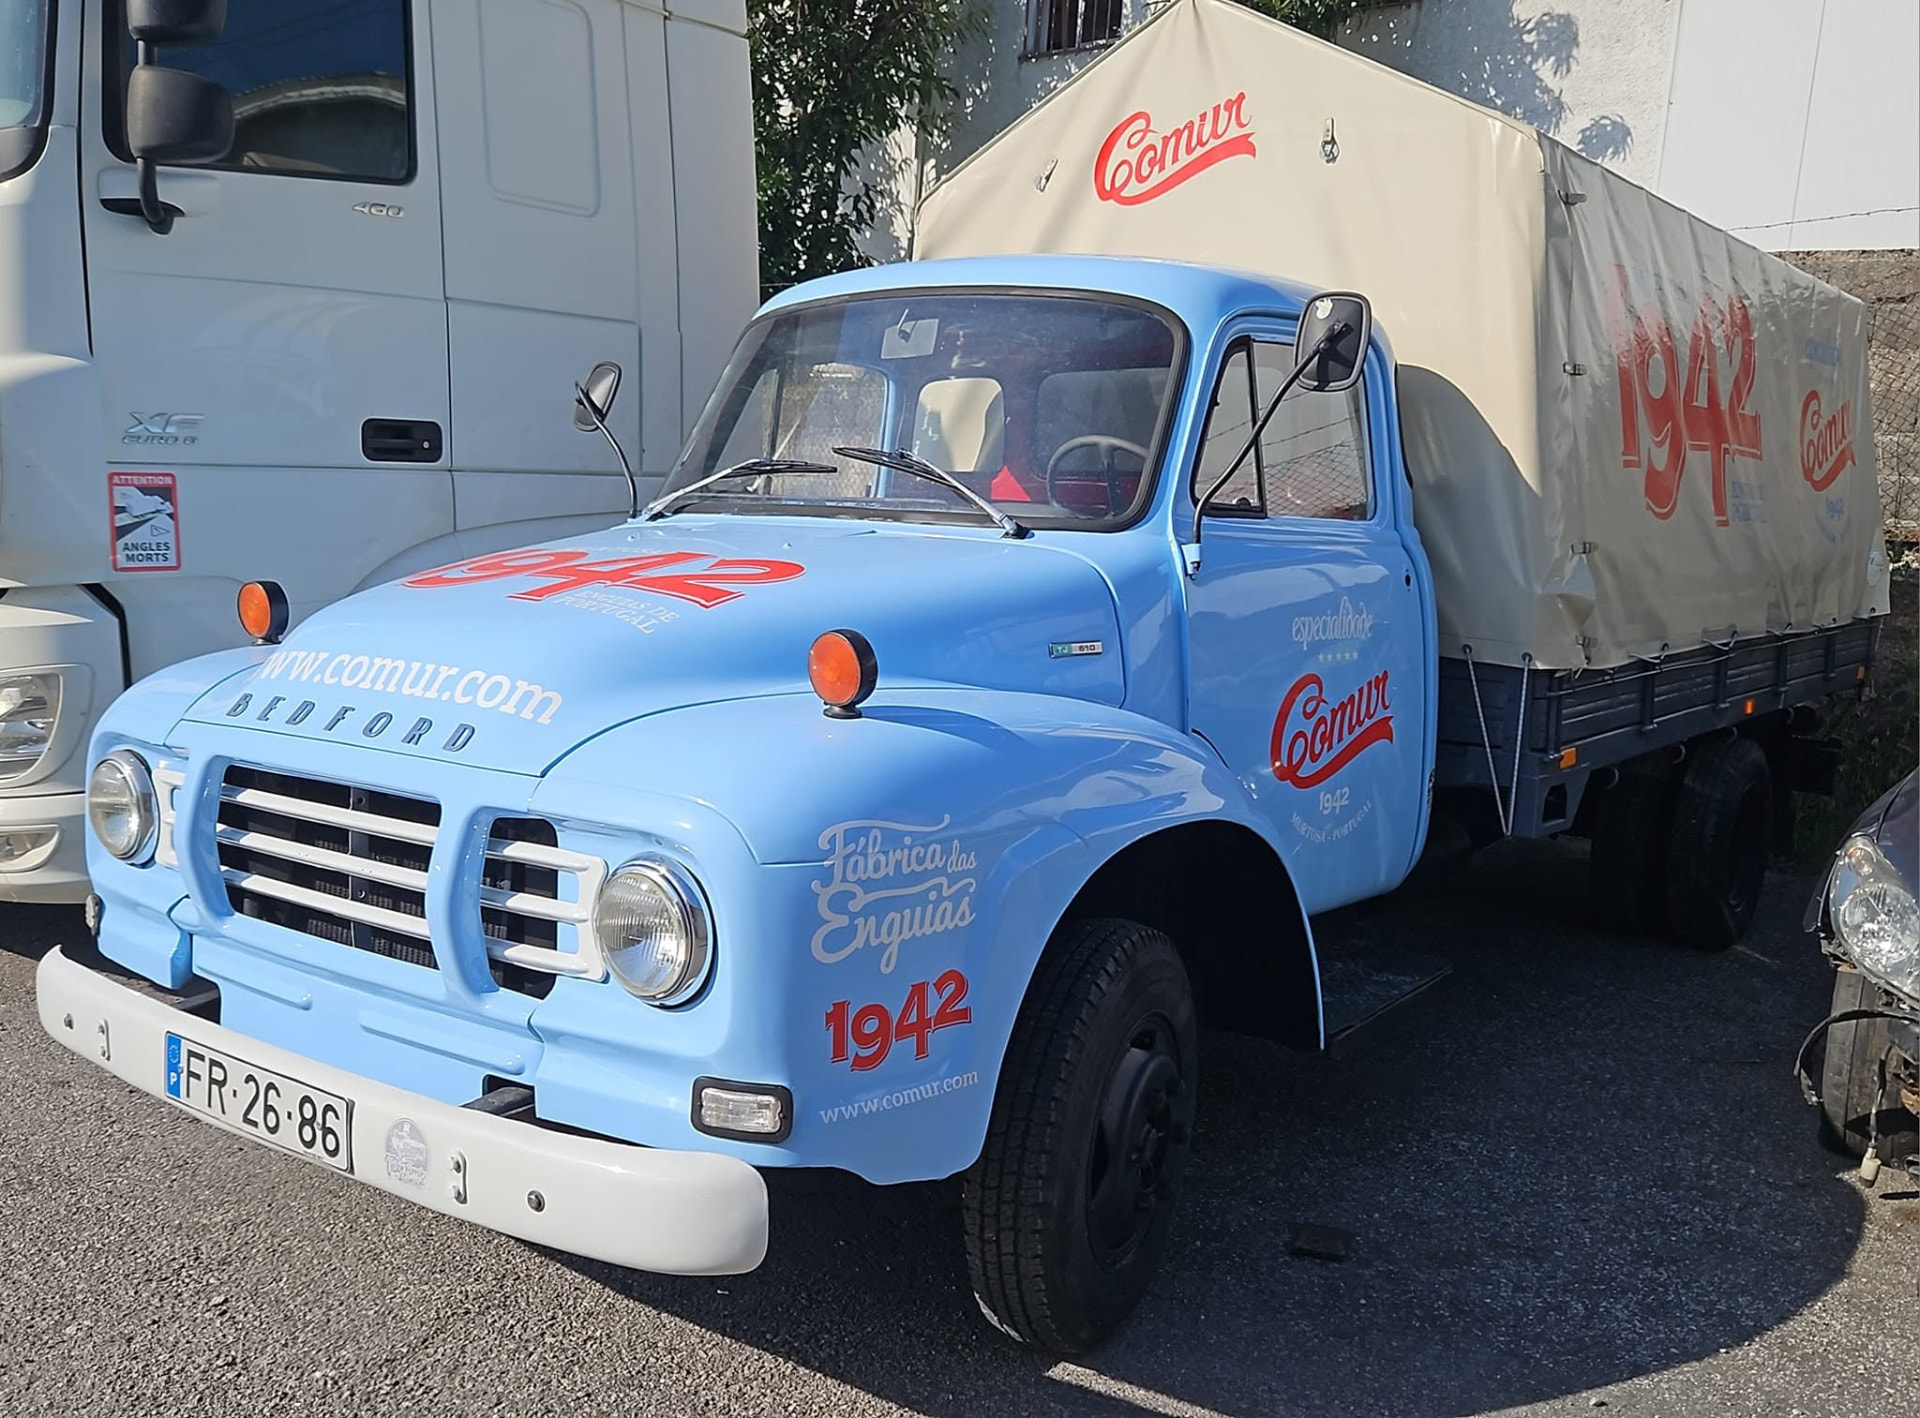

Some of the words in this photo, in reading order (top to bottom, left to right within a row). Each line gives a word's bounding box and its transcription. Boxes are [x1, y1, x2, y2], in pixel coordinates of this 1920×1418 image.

[1094, 91, 1256, 206] Comur
[351, 201, 405, 219] 460
[1604, 263, 1763, 527] 1942
[124, 411, 205, 434] XF
[112, 475, 173, 485] ATTENTION
[122, 541, 171, 552] ANGLES
[125, 552, 169, 563] MORTS
[647, 606, 680, 623] DE
[1292, 596, 1373, 651] especialidade
[254, 651, 564, 726] ww.comur.com
[226, 692, 476, 752] BEDFORD
[1271, 670, 1394, 790] Comur
[1320, 786, 1350, 815] 1942
[811, 814, 950, 892] Fábrica
[947, 839, 977, 873] das
[811, 877, 976, 974] Enguias
[824, 969, 972, 1072] 1942
[169, 1071, 178, 1086] P
[819, 1071, 979, 1124] www.comur.com
